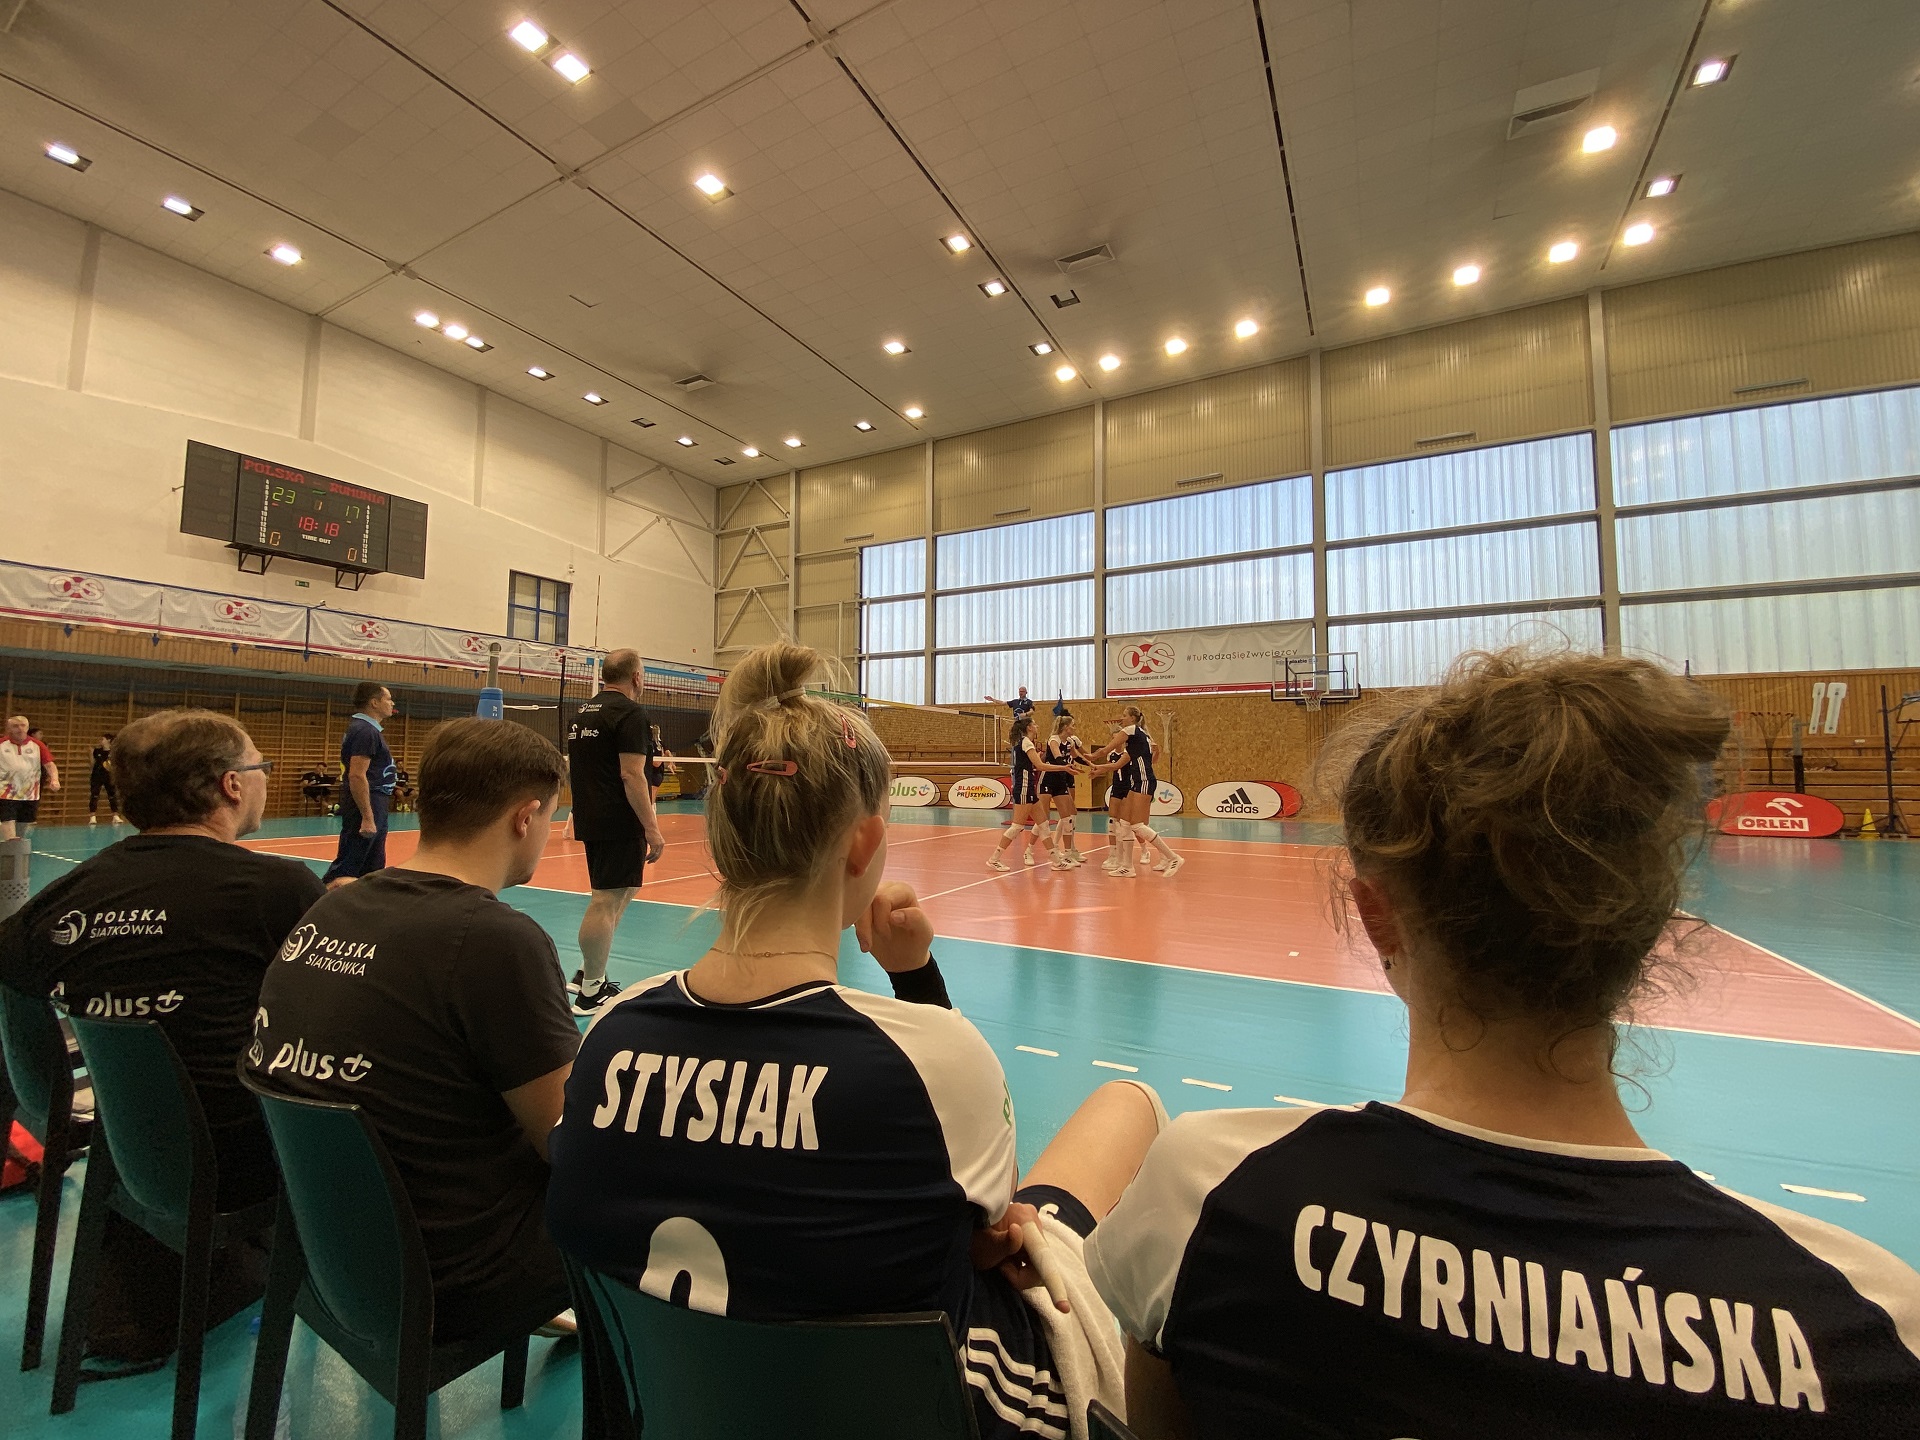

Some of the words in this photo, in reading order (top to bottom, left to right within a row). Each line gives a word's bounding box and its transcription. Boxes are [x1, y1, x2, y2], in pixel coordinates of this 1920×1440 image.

[243, 459, 305, 484] POLSKA
[329, 482, 385, 505] RUMUNIA
[272, 486, 296, 505] 23
[345, 505, 360, 519] 17
[298, 516, 340, 537] 18:18
[302, 534, 317, 542] TIME
[347, 547, 358, 562] 0
[1216, 804, 1259, 814] adidas
[1741, 817, 1804, 830] ORLEN
[94, 909, 167, 924] POLSKA
[89, 922, 163, 938] SIATKÓWKA
[315, 936, 377, 960] POLSKA
[305, 953, 366, 977] SIATKÓWKA
[268, 1037, 335, 1080] plus
[592, 1050, 829, 1150] STYSIAK
[1294, 1204, 1827, 1413] CZYRNIAŃSKA
